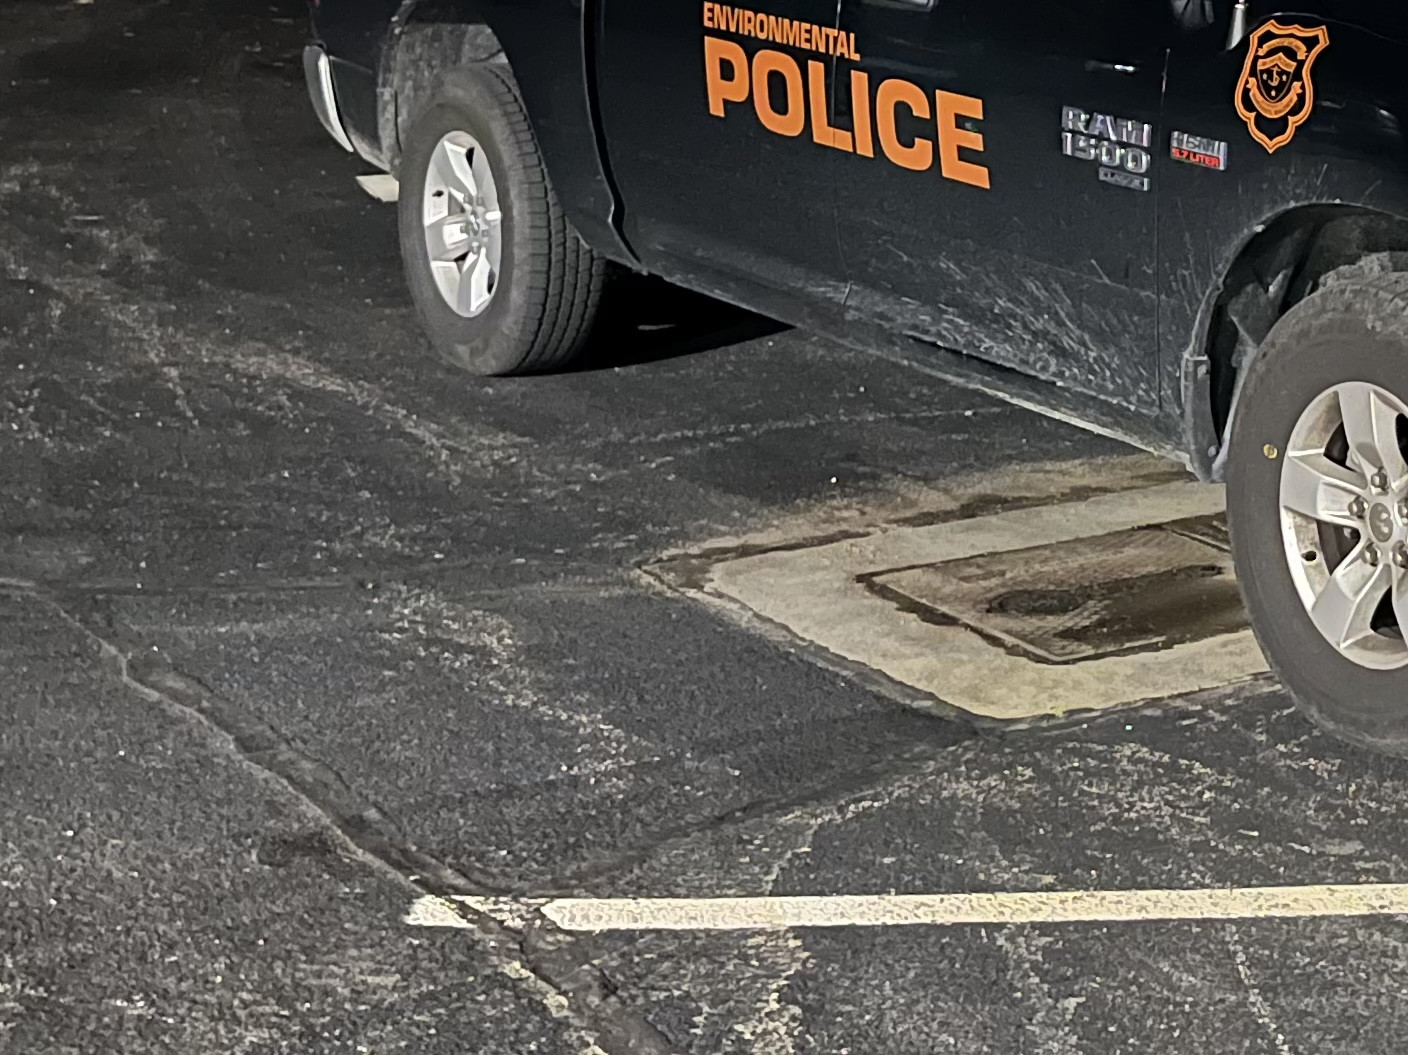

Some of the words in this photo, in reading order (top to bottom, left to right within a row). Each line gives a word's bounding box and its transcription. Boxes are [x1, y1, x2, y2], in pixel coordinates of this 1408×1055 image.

[703, 0, 861, 62] ENVIRONMENTAL
[704, 35, 991, 190] POLICE
[1062, 105, 1153, 148] RAM
[1062, 131, 1151, 174] 1500
